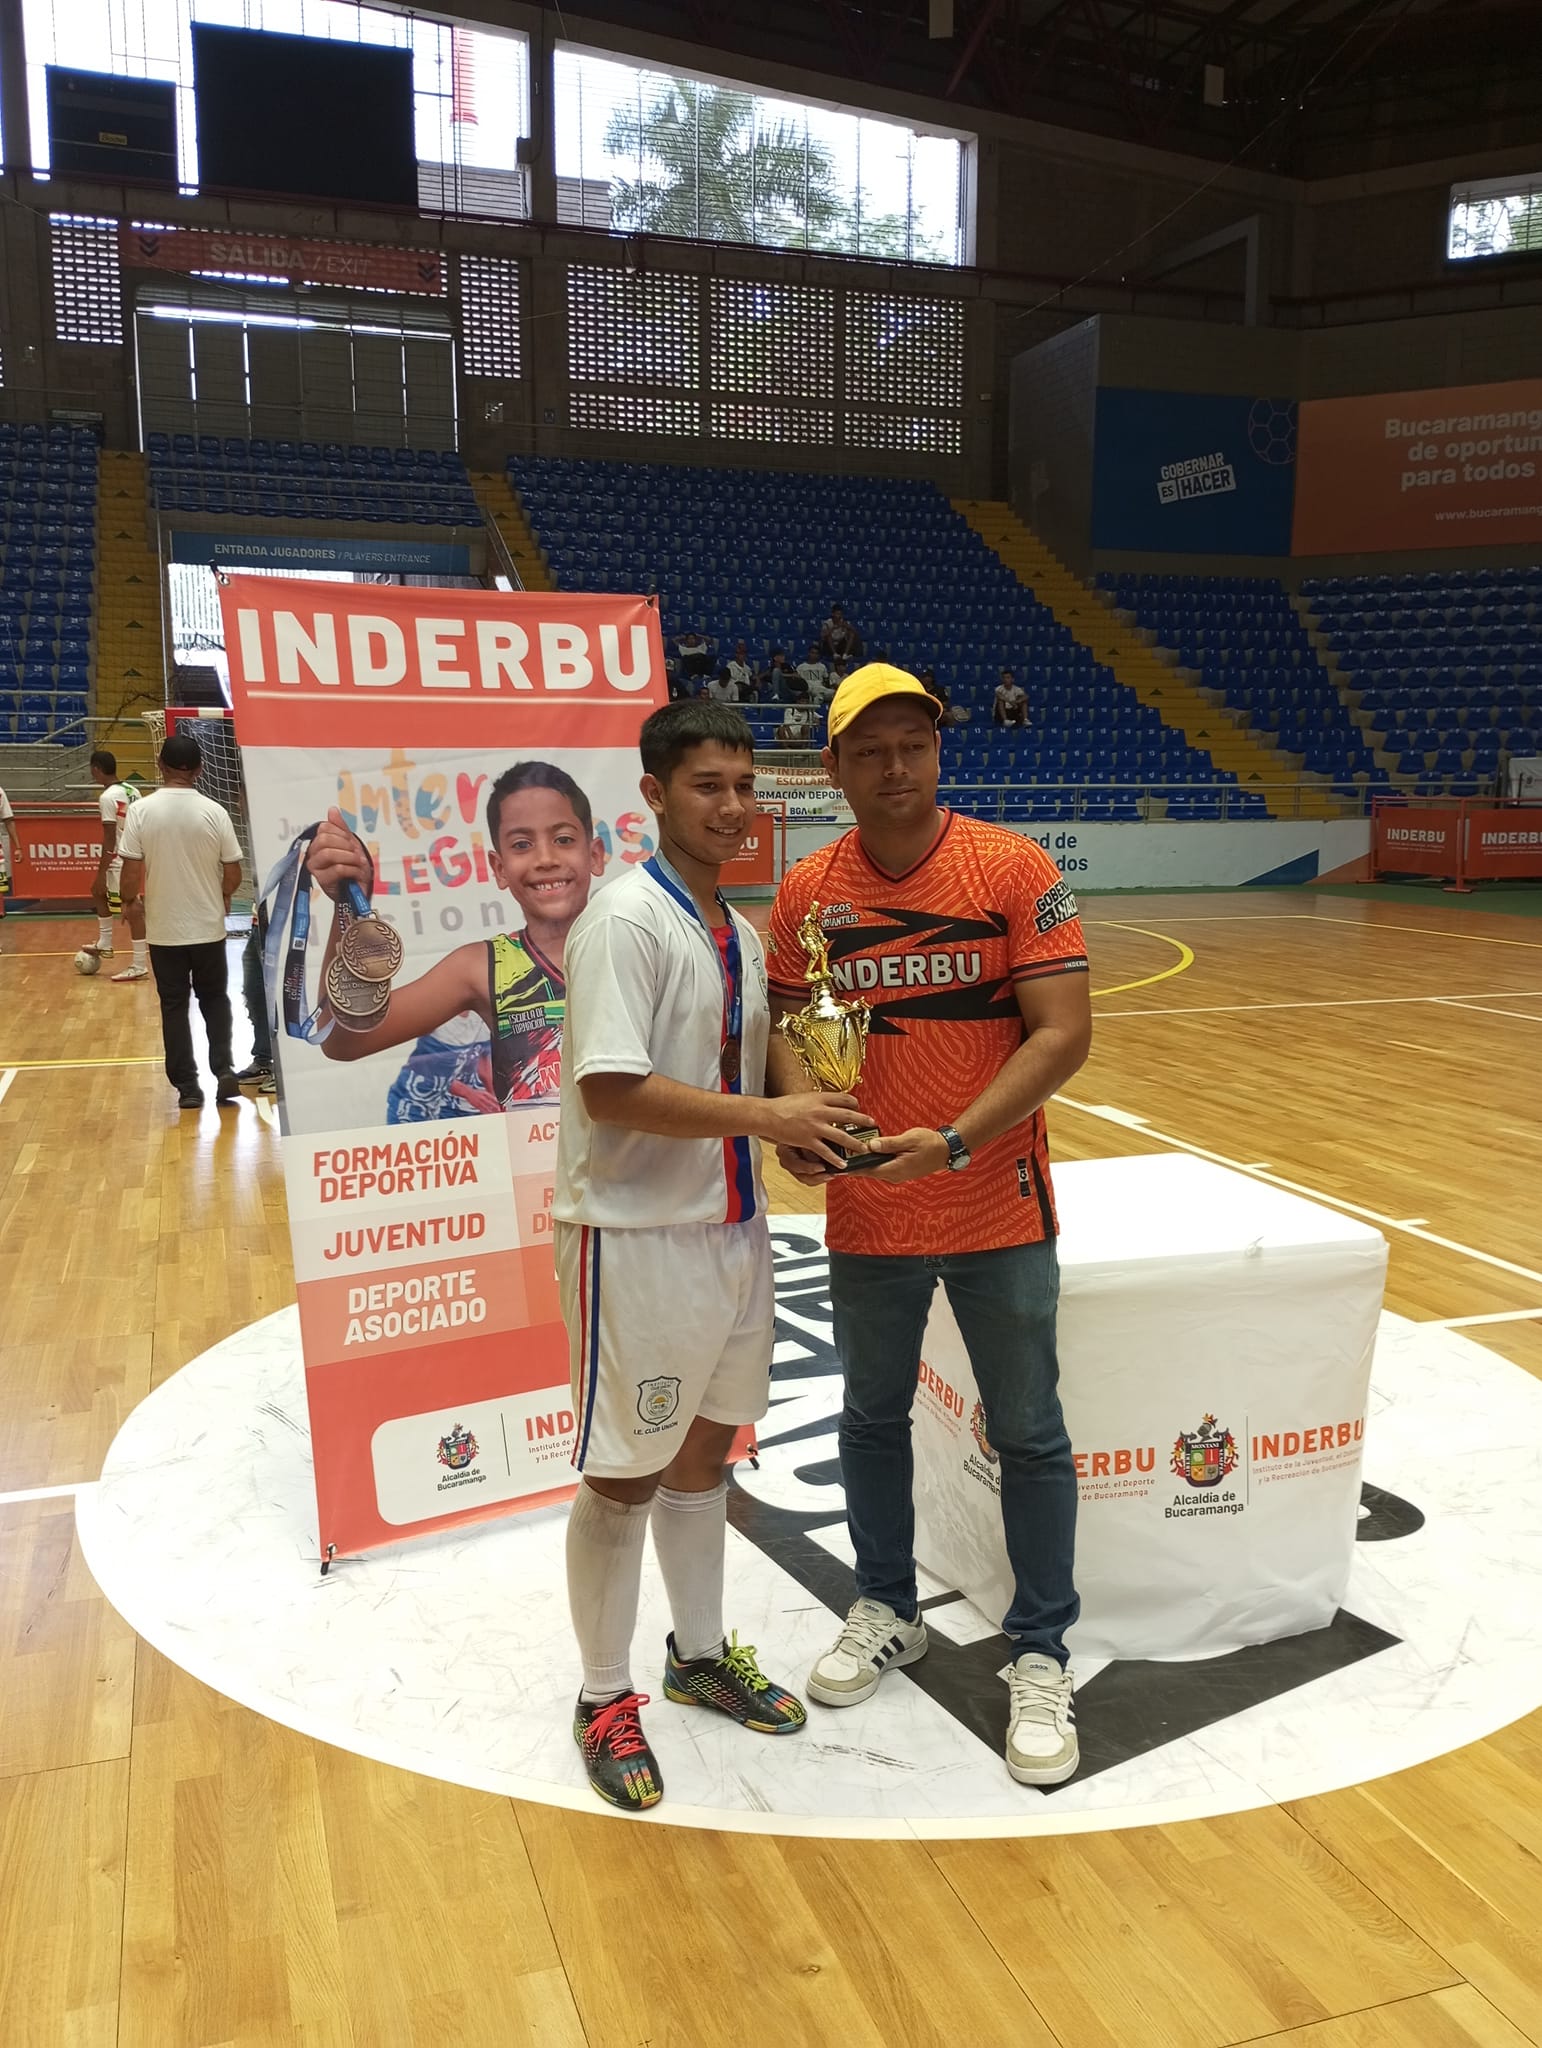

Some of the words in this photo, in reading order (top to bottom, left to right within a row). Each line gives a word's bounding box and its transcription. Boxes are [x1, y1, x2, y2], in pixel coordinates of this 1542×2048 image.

[210, 242, 305, 270] SALIDA
[327, 256, 372, 275] EXIT
[1408, 441, 1438, 461] de
[1160, 452, 1225, 480] GOBERNAR
[1401, 468, 1457, 492] para
[1463, 459, 1536, 482] todos
[1161, 486, 1174, 498] ES
[1180, 468, 1231, 497] HACER
[214, 543, 268, 556] ENTRADA
[270, 546, 336, 559] JUGADORES
[344, 551, 383, 562] PLAYERS
[384, 552, 432, 563] ENTRANCE
[237, 608, 652, 692] INDERBU
[337, 747, 489, 840] Inter
[1055, 832, 1078, 849] de
[1387, 828, 1446, 843] INDERBU
[1040, 914, 1054, 930] ES
[313, 1131, 479, 1177] FORMACIÓN
[319, 1159, 479, 1203] DEPORTIVA
[323, 1212, 486, 1260] JUVENTUD
[348, 1269, 477, 1314] DEPORTE
[343, 1297, 487, 1346] ASOCIADO
[645, 1426, 661, 1435] CLUB
[1252, 1417, 1364, 1461] INDERBU
[529, 1442, 560, 1453] Instituto
[471, 1468, 480, 1476] de
[1252, 1464, 1283, 1474] Instituto
[1311, 1467, 1320, 1475] de
[437, 1475, 487, 1491] Bucaramanga
[1123, 1479, 1155, 1488] Deporte
[1081, 1493, 1092, 1501] de
[1094, 1489, 1149, 1500] Bucaramanga
[1222, 1490, 1236, 1502] de
[1164, 1503, 1244, 1519] Bucaramanga
